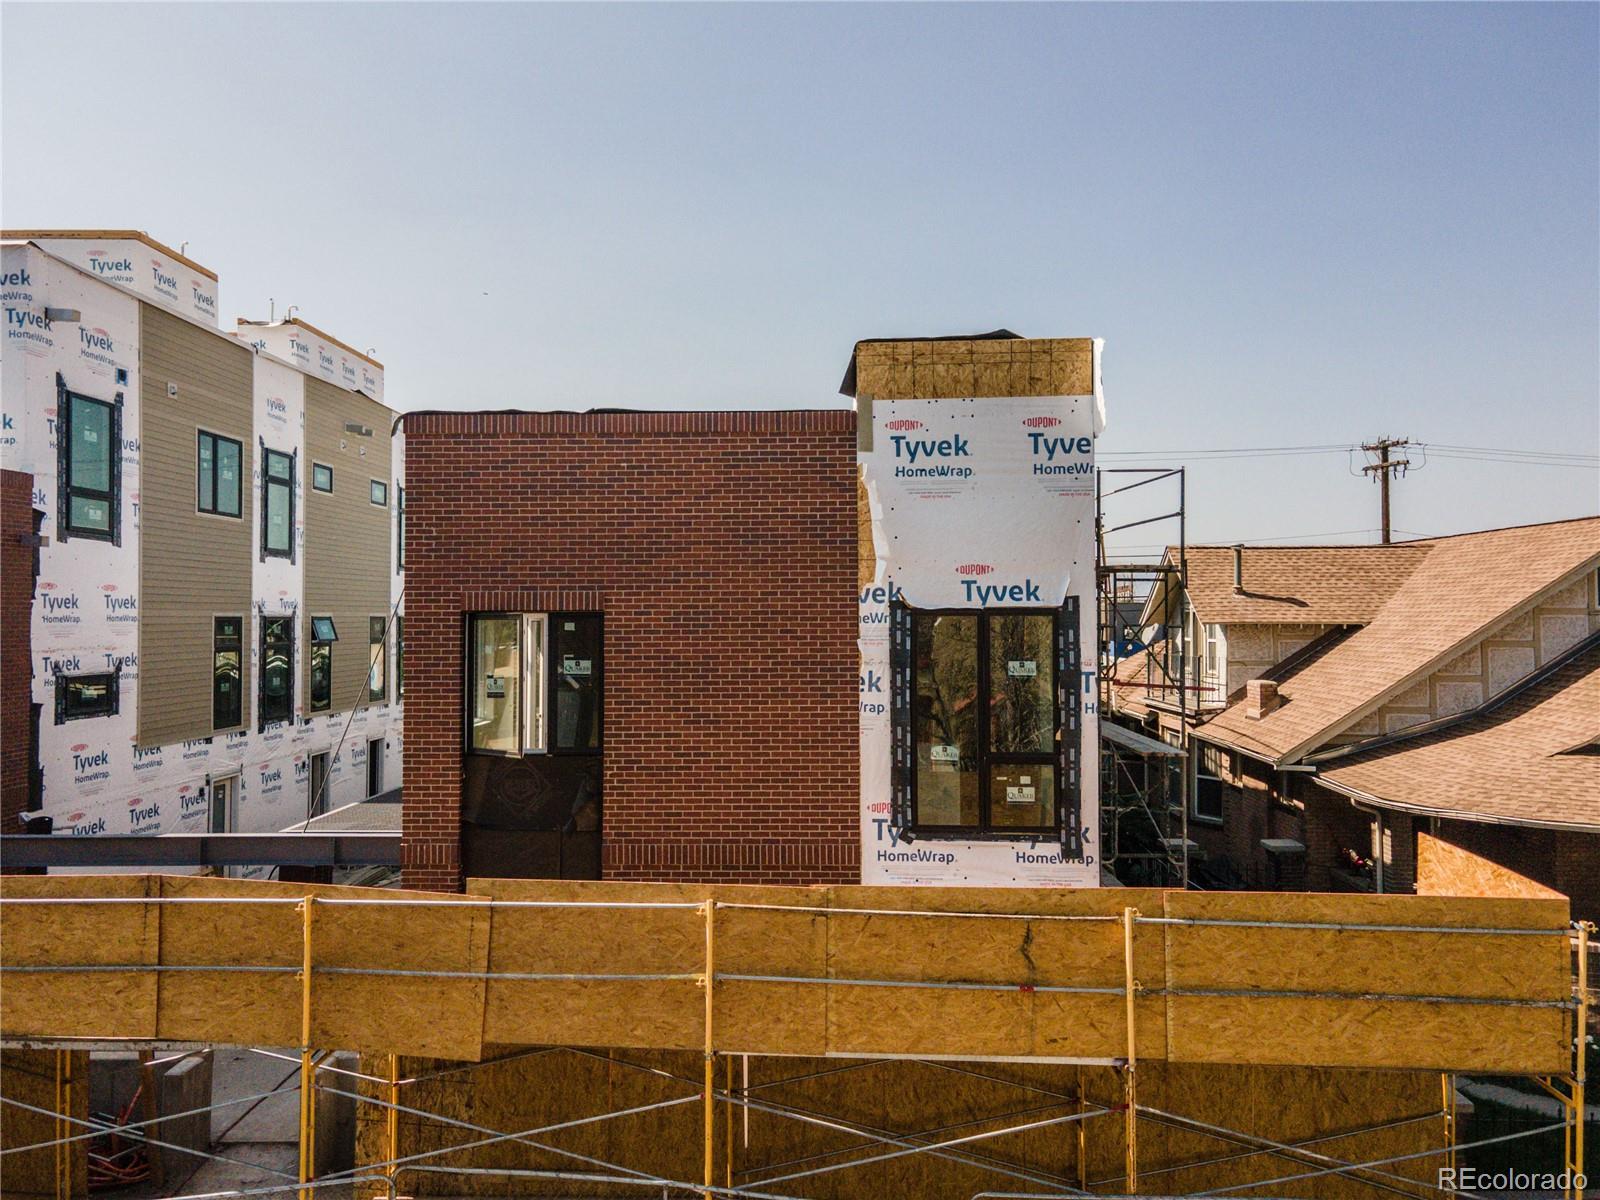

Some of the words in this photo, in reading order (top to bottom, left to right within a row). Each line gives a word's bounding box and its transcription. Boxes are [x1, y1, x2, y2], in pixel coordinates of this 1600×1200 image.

[89, 258, 132, 274] Tyvek
[152, 267, 177, 290] Tyvek
[192, 287, 215, 308] Tyvek
[5, 307, 52, 332] Tyvek
[8, 329, 54, 346] HomeWrap
[78, 326, 114, 353] Tyvek
[889, 419, 920, 431] DUPONT
[1026, 416, 1058, 428] DUPONT
[890, 434, 969, 463] Tyvek
[1027, 432, 1092, 461] Tyve
[895, 465, 973, 479] HomeWrap
[959, 563, 991, 575] DUPONT
[961, 579, 1041, 607] Tyvek
[41, 593, 79, 614] Tyvek
[104, 594, 136, 613] Tyvek
[43, 614, 80, 623] HomeWrap
[106, 614, 138, 623] HomeWrap
[73, 750, 108, 774] Tyvek
[133, 759, 163, 771] HomeWrap
[75, 771, 110, 784] HomeWrap
[260, 769, 282, 787] Tyvek
[128, 803, 160, 826] Tyvek
[877, 849, 955, 865] HomeWrap
